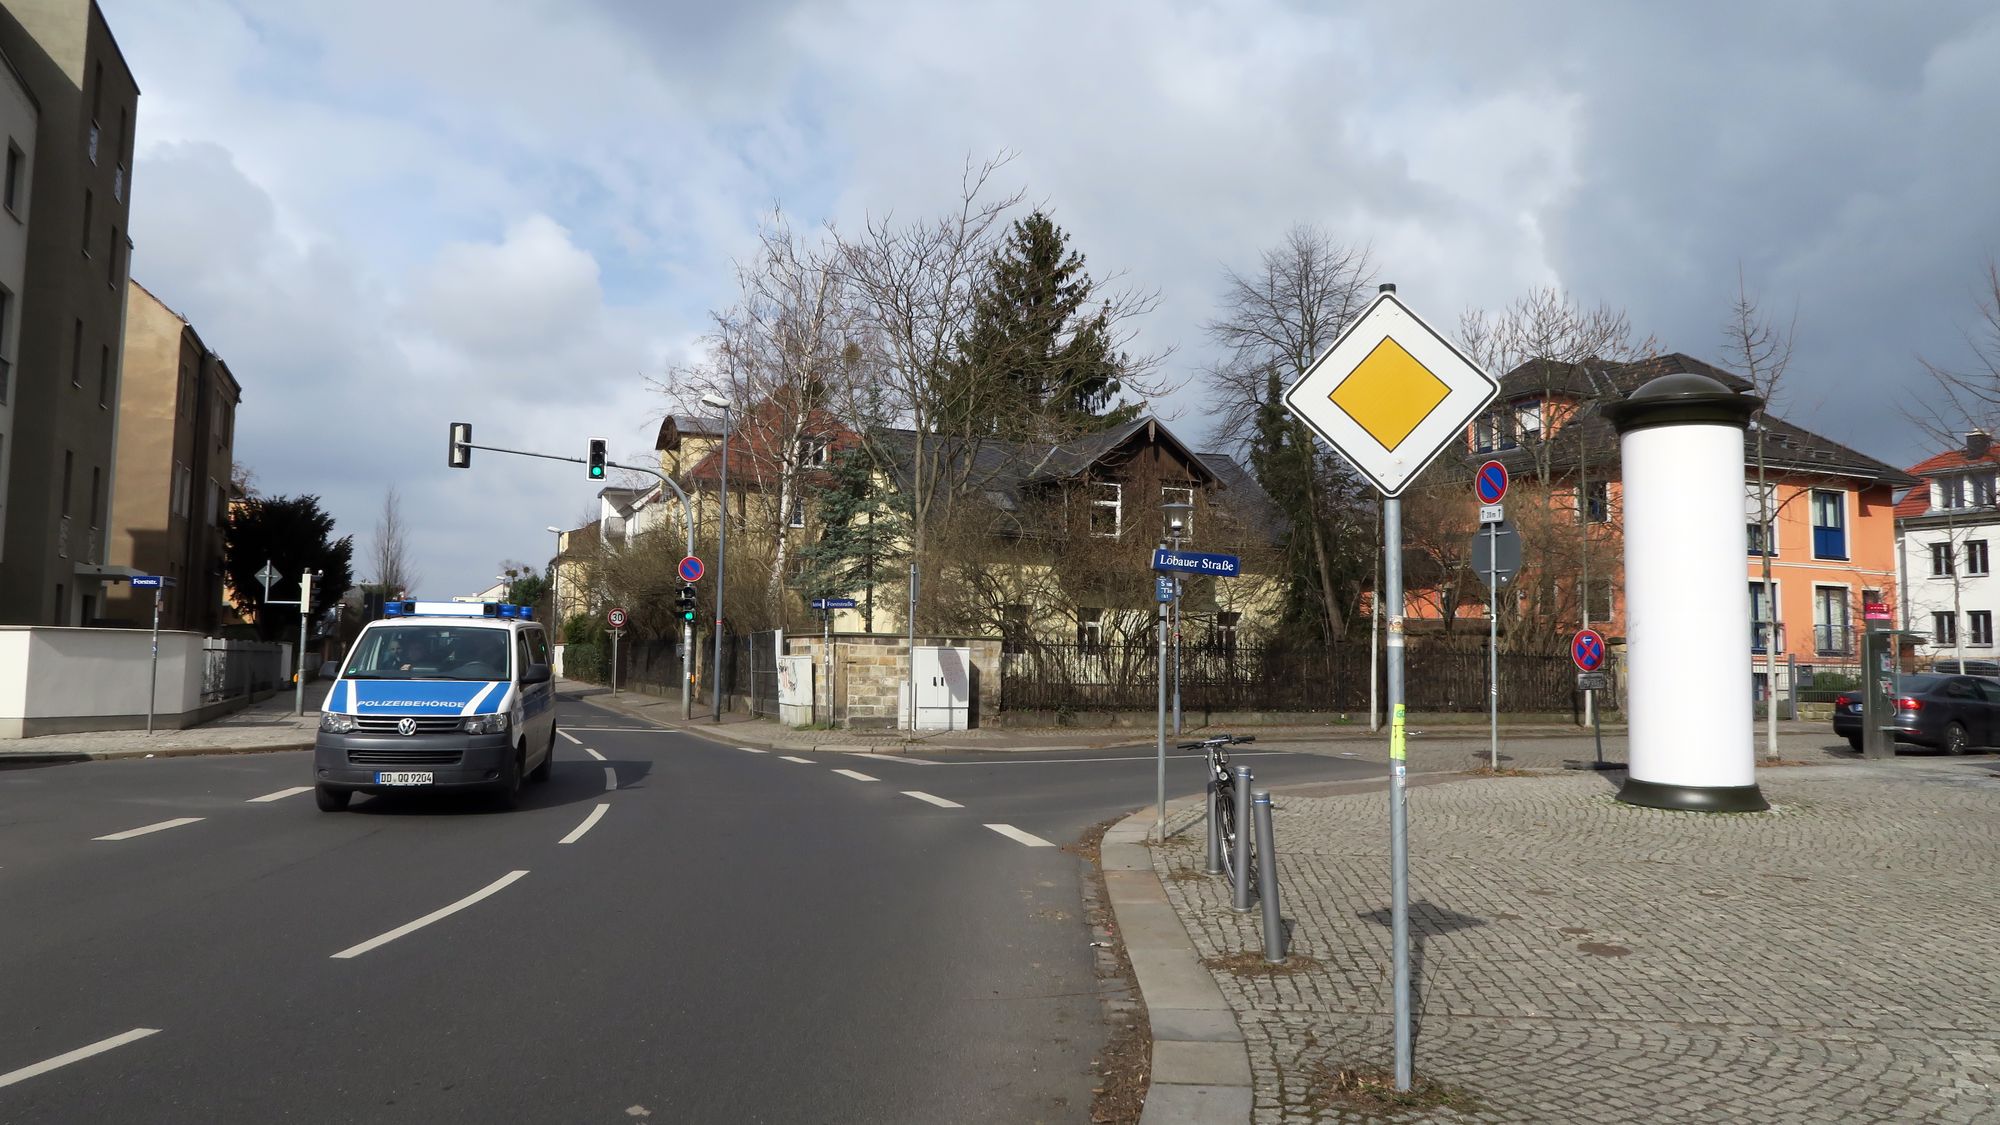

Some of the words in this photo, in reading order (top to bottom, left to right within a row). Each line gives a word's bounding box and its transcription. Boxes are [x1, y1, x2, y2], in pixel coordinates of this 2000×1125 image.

[1160, 554, 1199, 568] Löbauer
[1201, 558, 1234, 571] Straße
[612, 613, 623, 622] 30
[357, 700, 465, 708] POLIZEIBEHÖRDE
[381, 773, 391, 782] DD
[411, 773, 432, 782] 9204
